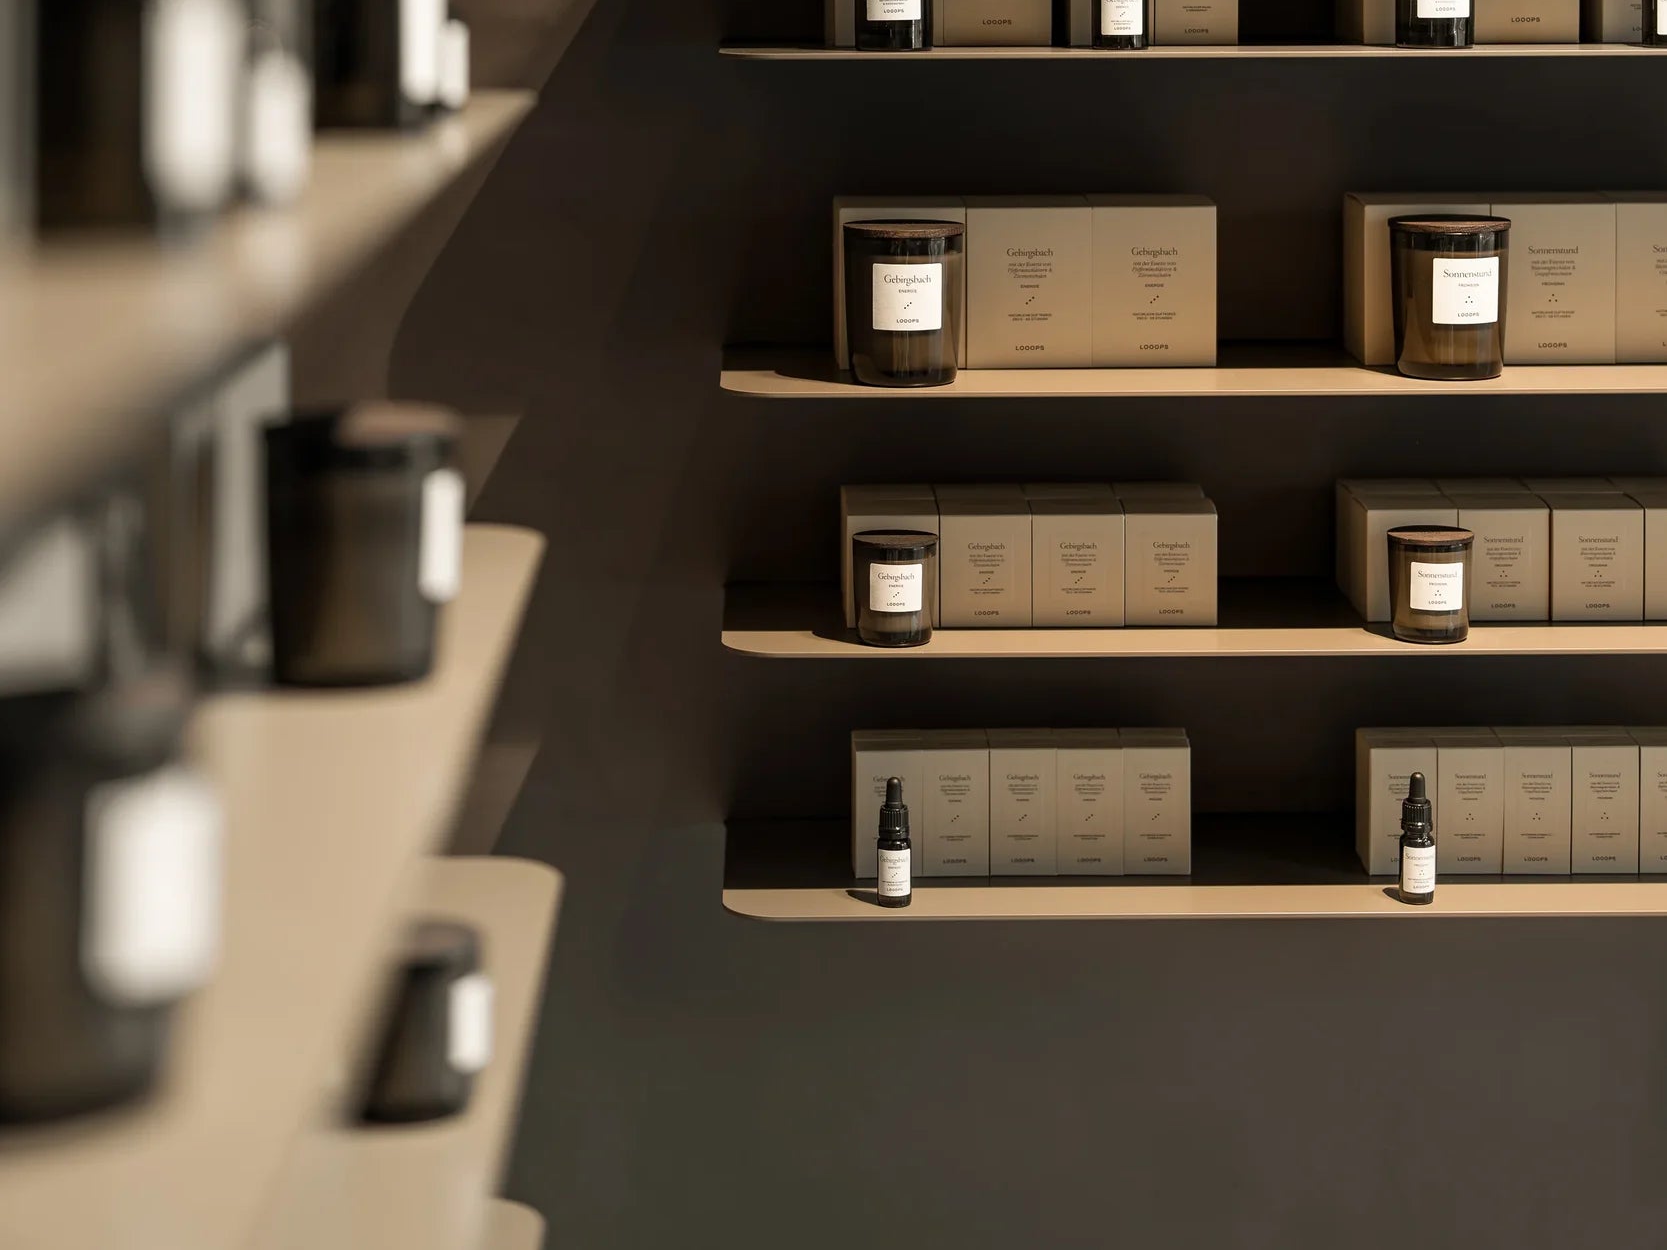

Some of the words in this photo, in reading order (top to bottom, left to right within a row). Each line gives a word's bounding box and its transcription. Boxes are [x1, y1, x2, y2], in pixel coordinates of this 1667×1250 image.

[1007, 248, 1054, 259] Gebirgsbach
[1131, 247, 1178, 258] Gebirgsbach
[1528, 245, 1579, 255] Sonnenstund
[1443, 268, 1492, 278] Sonnenstund
[883, 274, 933, 286] Gebirgsbach
[1484, 535, 1524, 544] Sonnenstund
[1578, 535, 1618, 544] Sonnenstund
[968, 542, 1006, 553] Gebirgsbach
[1060, 541, 1098, 552] Gebirgsbach
[1152, 541, 1190, 551] Gebirgsbach
[877, 573, 916, 583] Gebirgsbach
[1417, 570, 1458, 579] Sonnenstund
